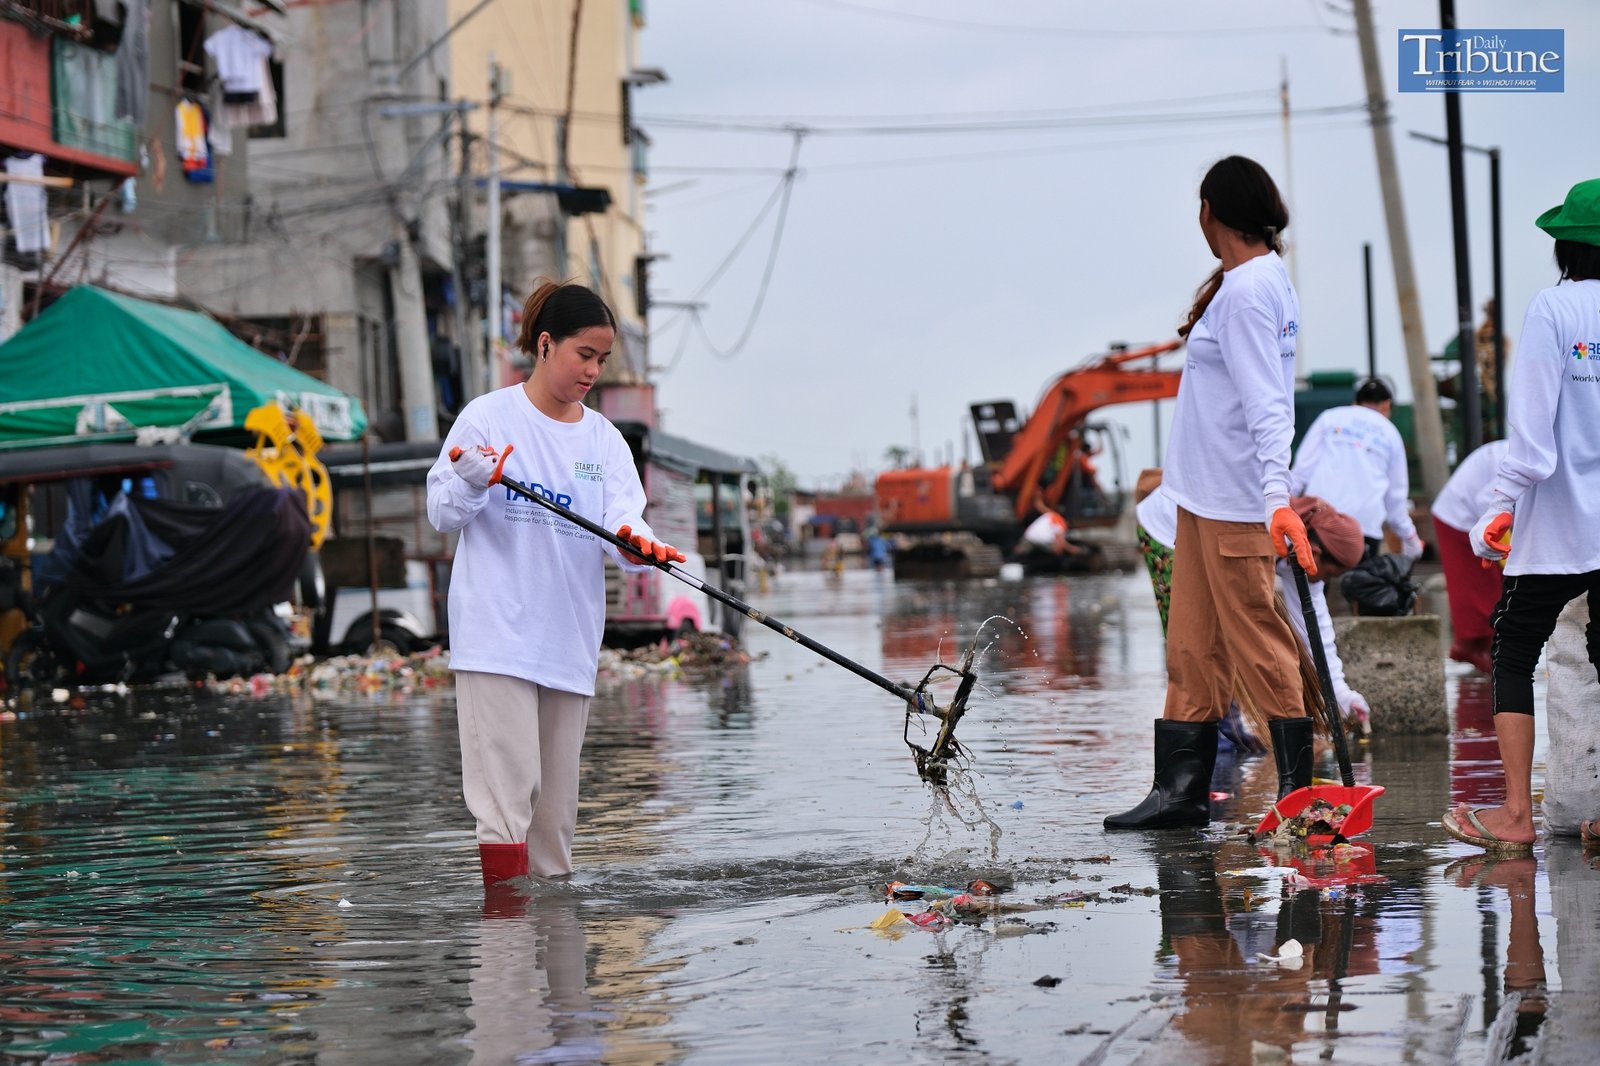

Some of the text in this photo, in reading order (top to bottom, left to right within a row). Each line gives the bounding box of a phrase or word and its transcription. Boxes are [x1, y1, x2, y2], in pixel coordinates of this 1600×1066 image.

[574, 462, 594, 472] START
[574, 472, 589, 480] START
[505, 508, 529, 516] Inclusive
[554, 520, 578, 530] Disease
[504, 514, 531, 523] Response
[574, 531, 596, 542] Carina
